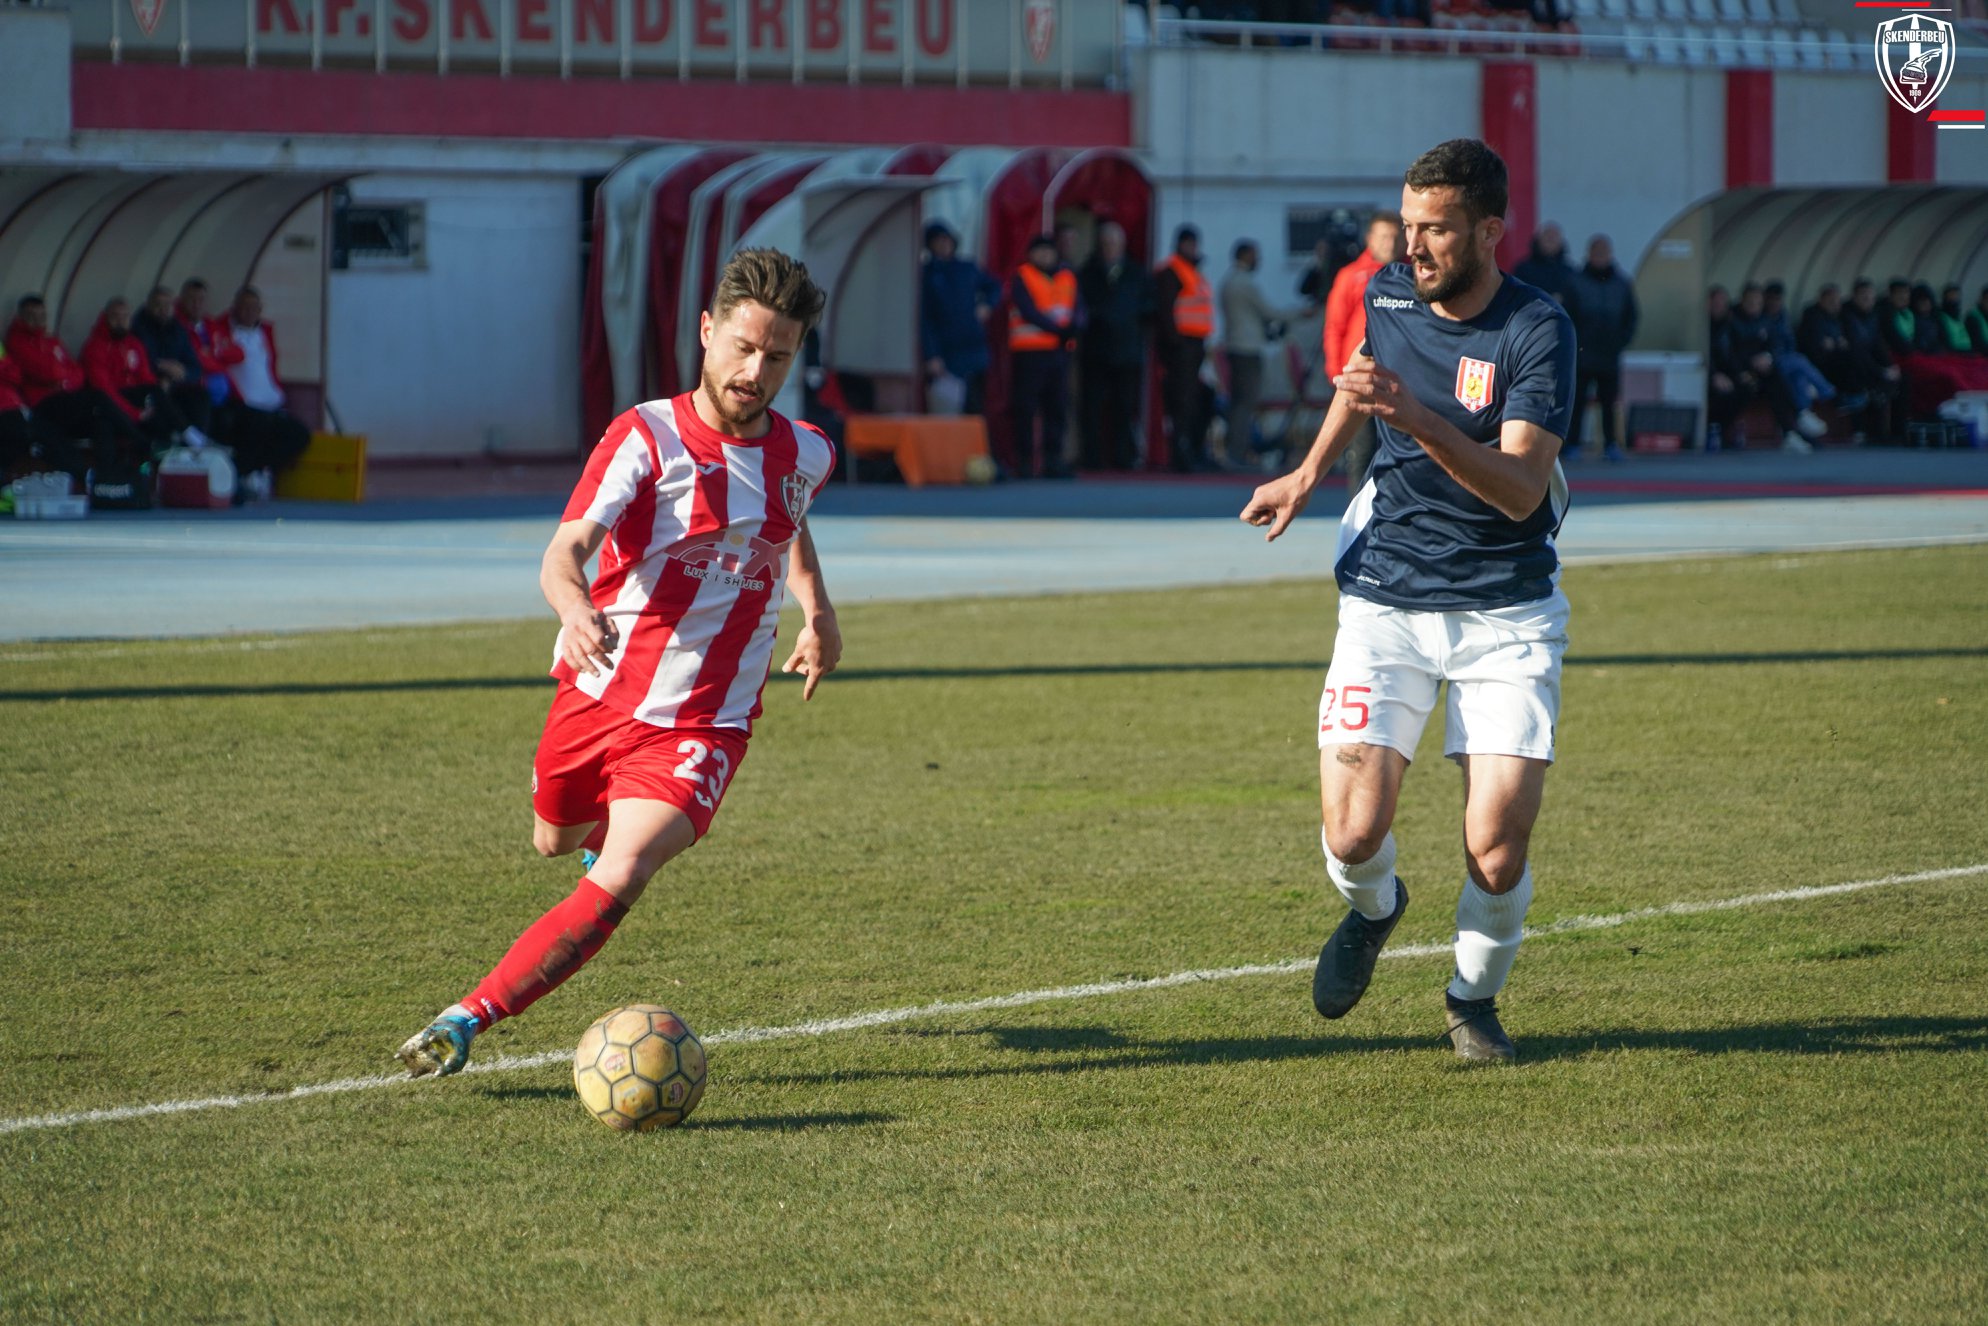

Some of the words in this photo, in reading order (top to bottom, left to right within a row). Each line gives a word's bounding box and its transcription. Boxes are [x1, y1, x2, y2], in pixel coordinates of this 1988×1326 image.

[1372, 296, 1414, 310] uhlsport
[684, 566, 709, 580] LUX
[714, 573, 719, 582] I
[724, 575, 764, 591] SHIJES
[1321, 685, 1372, 732] 25
[672, 740, 729, 802] 23
